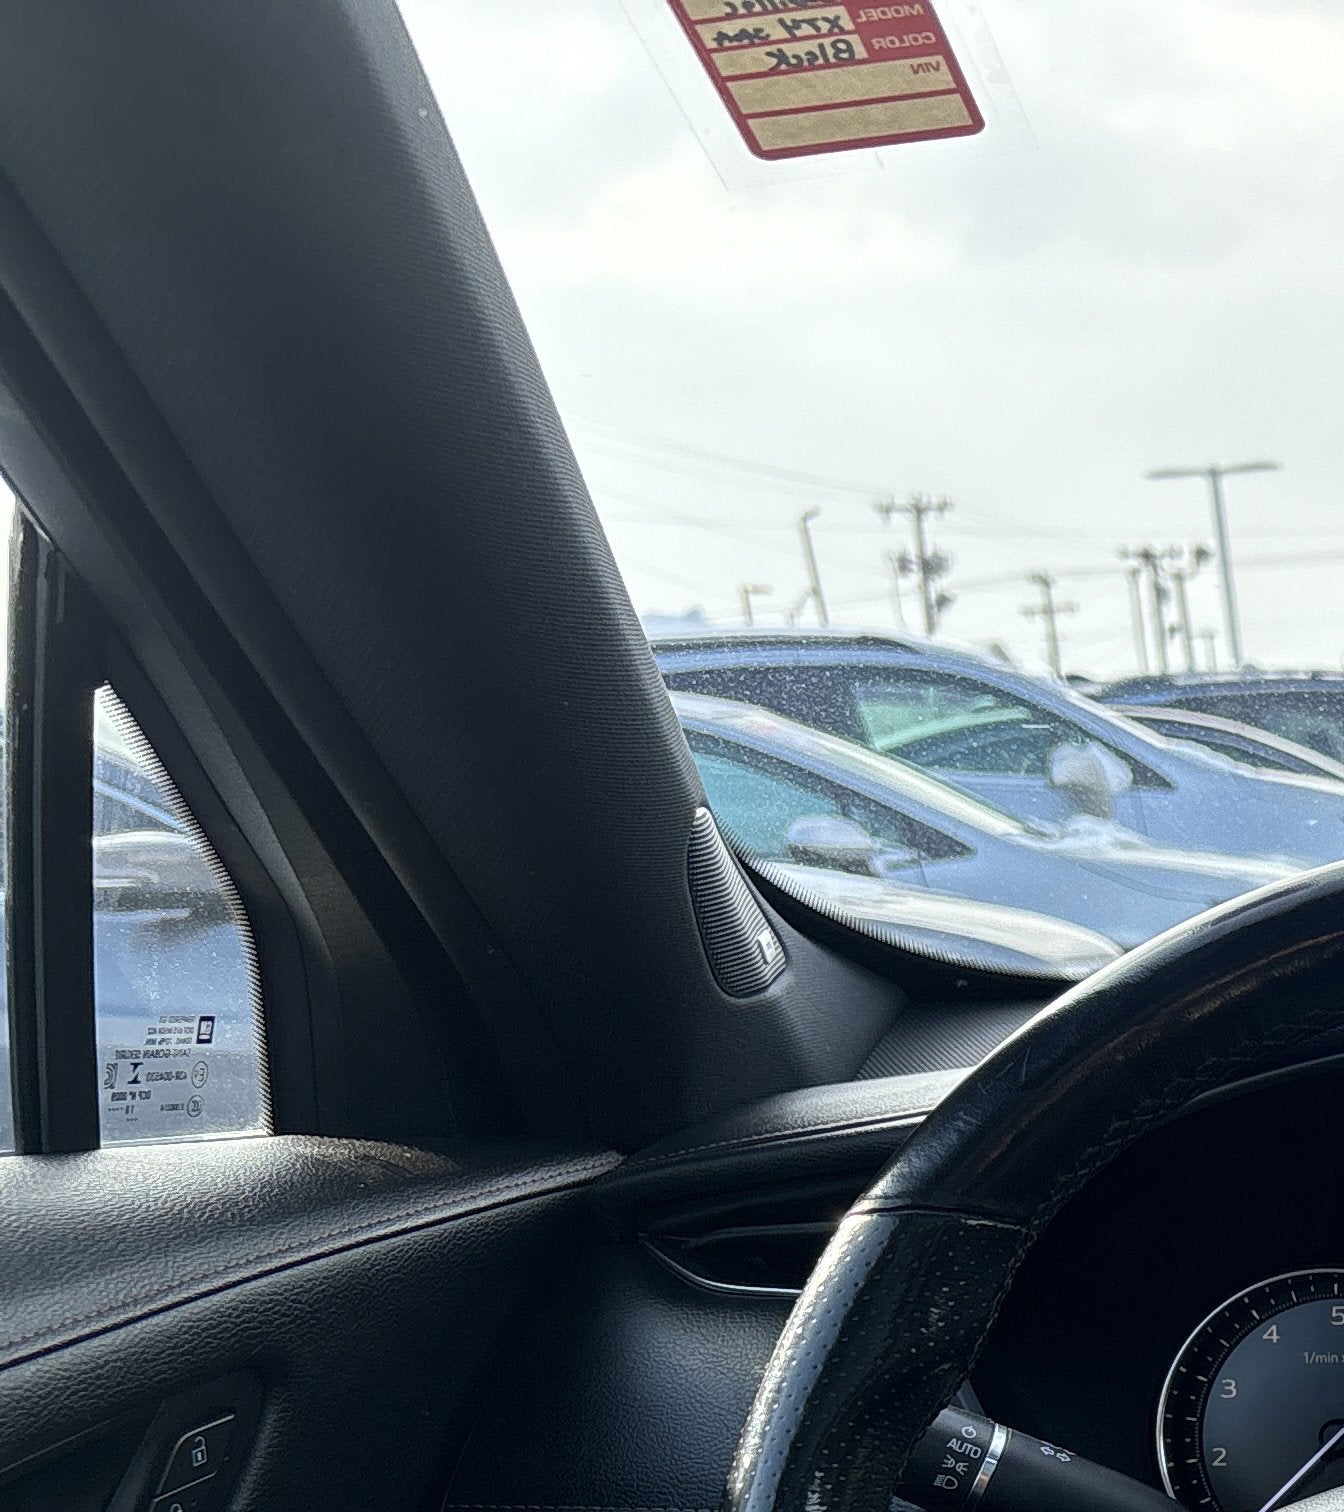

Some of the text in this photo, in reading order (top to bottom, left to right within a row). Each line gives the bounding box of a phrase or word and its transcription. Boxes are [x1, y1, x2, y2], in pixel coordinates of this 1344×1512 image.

[1262, 1324, 1281, 1344] 4
[1303, 1351, 1339, 1364] 1/min
[1219, 1379, 1237, 1399] 3
[946, 1437, 982, 1460] AUTO
[1211, 1447, 1228, 1467] 2
